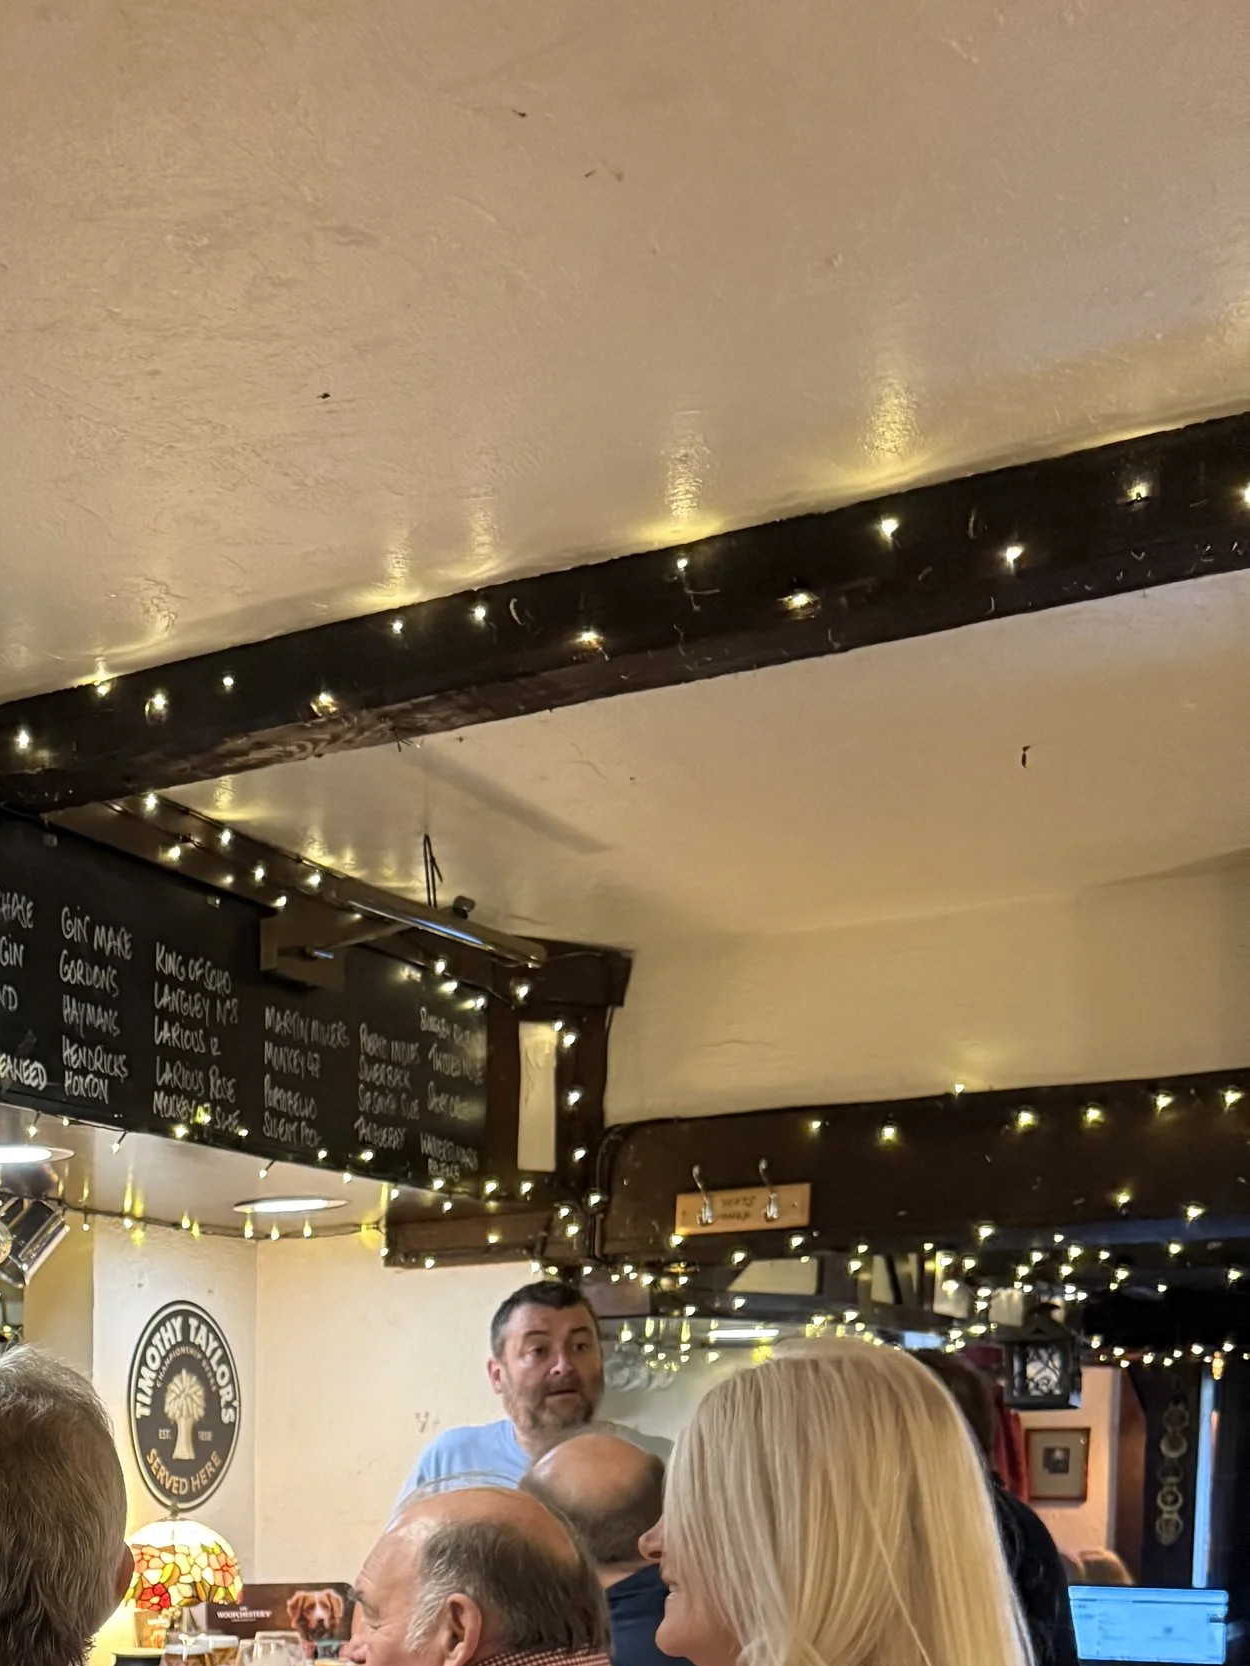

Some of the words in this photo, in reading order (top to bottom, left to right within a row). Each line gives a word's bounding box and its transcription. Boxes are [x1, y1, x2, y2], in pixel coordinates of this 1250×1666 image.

[154, 941, 187, 982] KING
[135, 1315, 183, 1421] TIMOTHY
[188, 1316, 240, 1426] TAYLOR'S
[146, 1447, 189, 1496] SERVED
[190, 1450, 223, 1494] HERE
